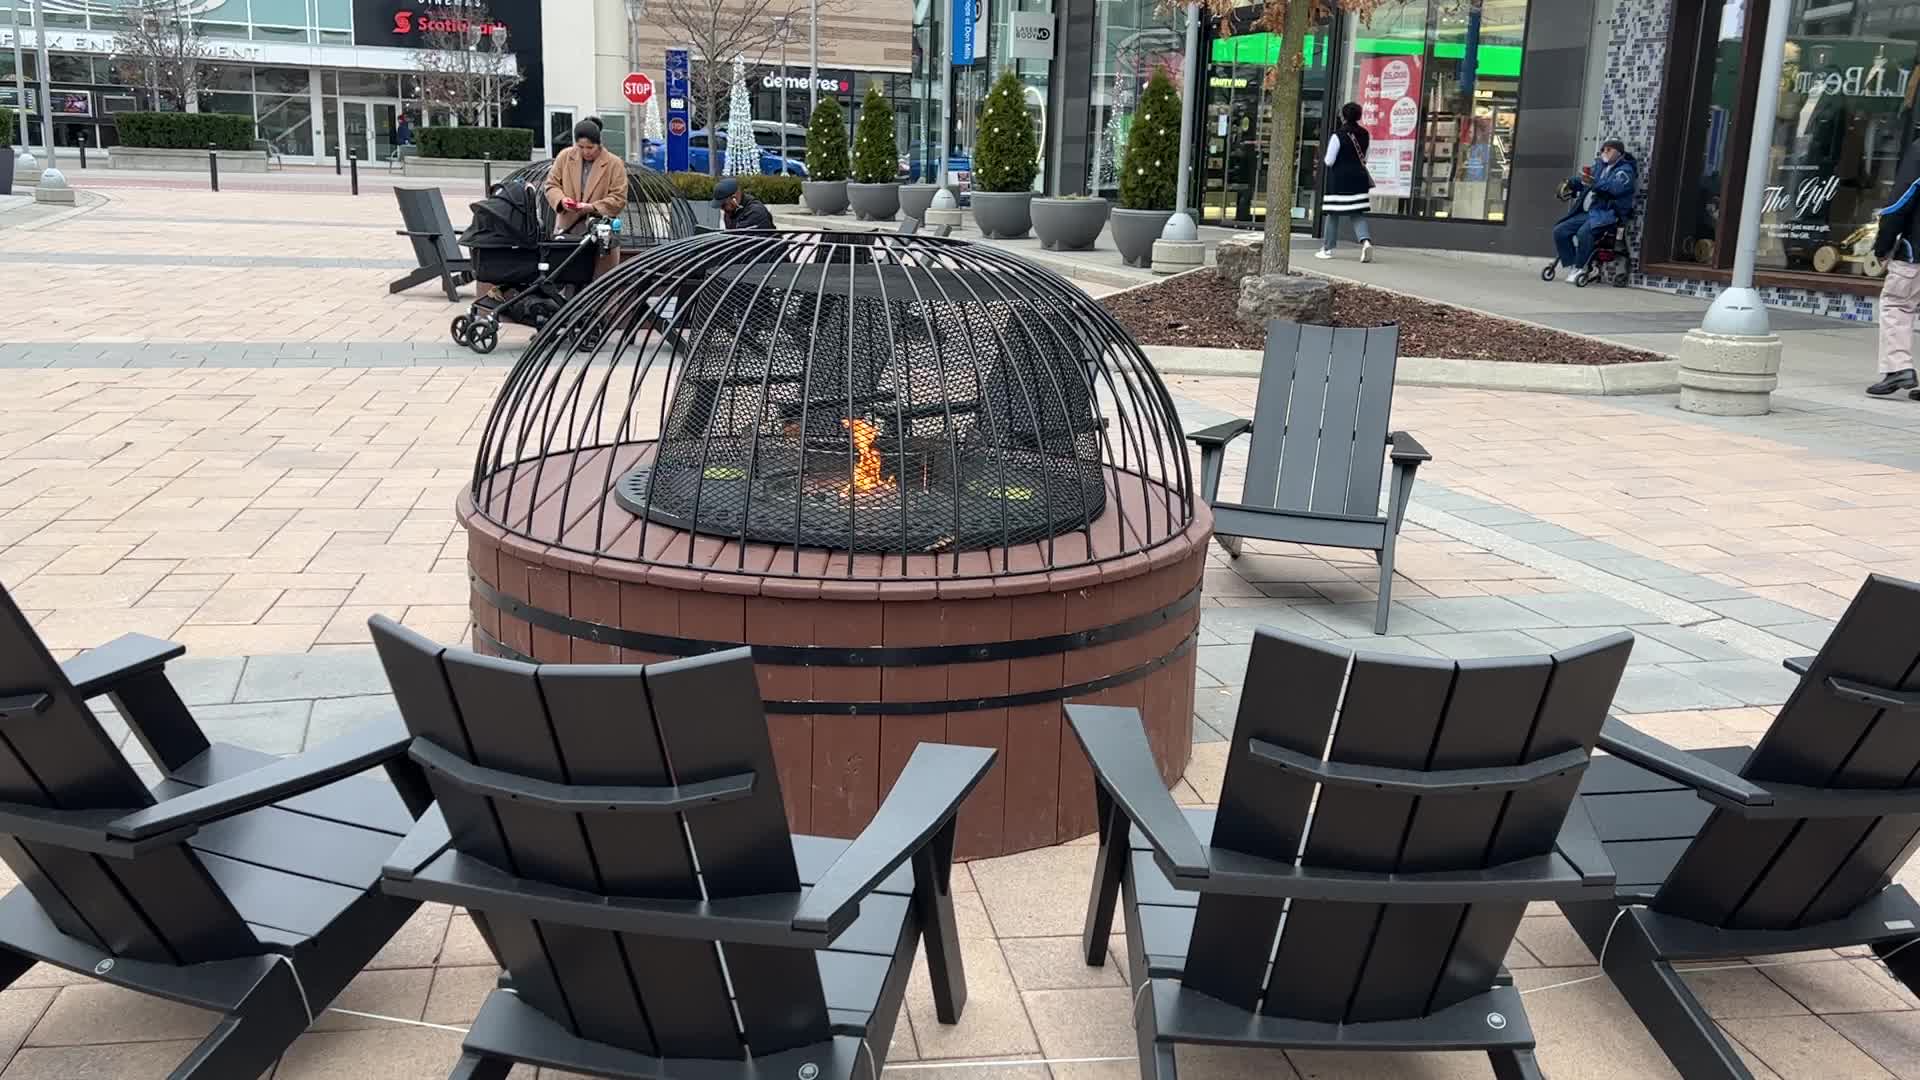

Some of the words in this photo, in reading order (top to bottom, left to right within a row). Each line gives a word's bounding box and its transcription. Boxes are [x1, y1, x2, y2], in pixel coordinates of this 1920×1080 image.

[418, 16, 507, 35] Scotiaan
[964, 26, 972, 42] Don
[624, 82, 651, 95] STOP
[1760, 186, 1790, 214] The
[1795, 175, 1840, 218] Gift
